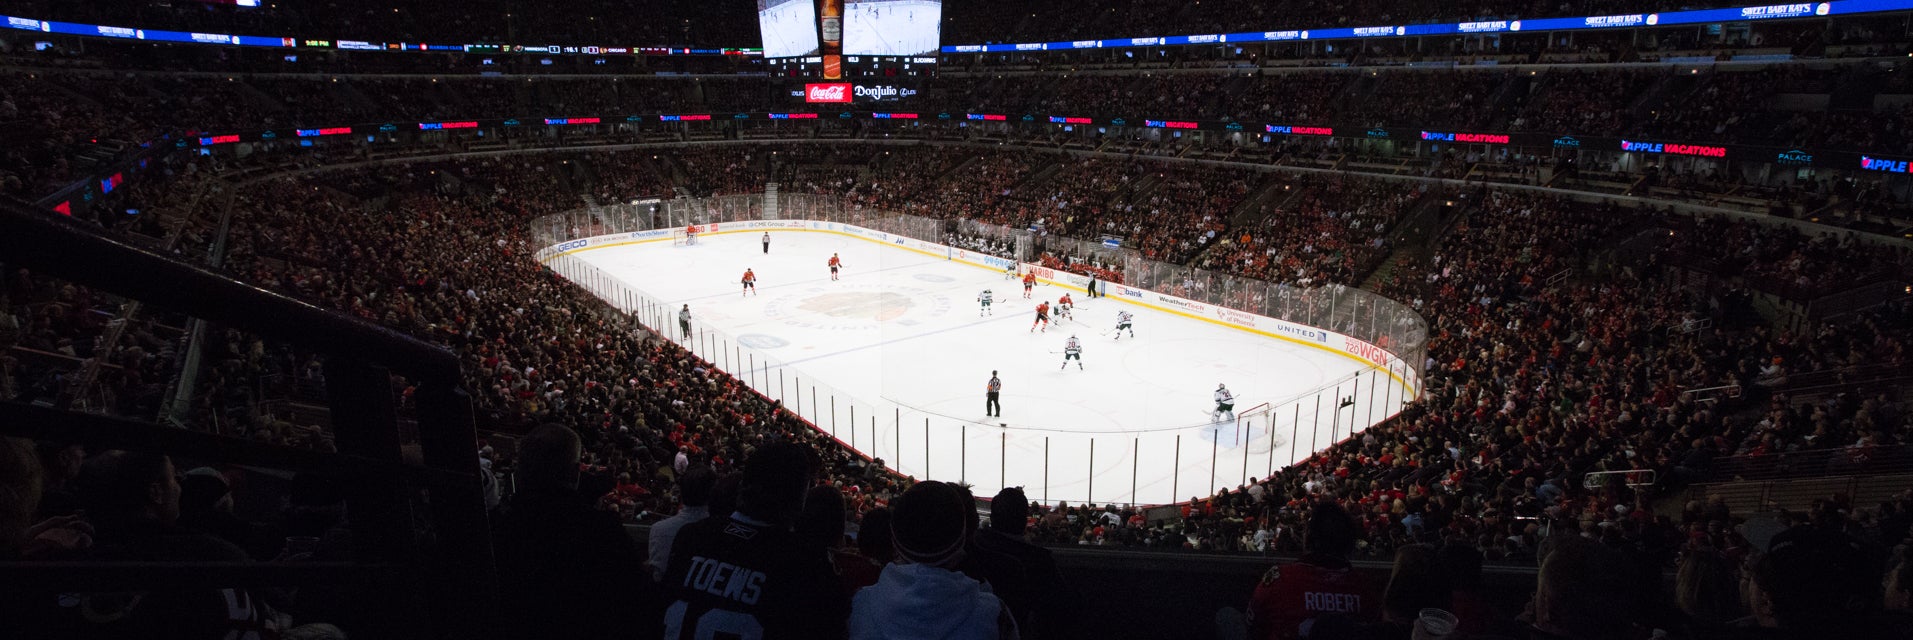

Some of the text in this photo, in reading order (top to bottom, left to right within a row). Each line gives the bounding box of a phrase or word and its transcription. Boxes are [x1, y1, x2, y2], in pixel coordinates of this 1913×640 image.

[1741, 7, 1767, 17] SWEET
[1767, 5, 1789, 14] BABY
[1585, 16, 1607, 25] SWEET
[1607, 15, 1624, 23] BABY
[1269, 125, 1333, 136] APPLE VACATIONS
[1426, 131, 1510, 144] APPLE VACATIONS
[1626, 142, 1726, 157] APPLE VACATIONS
[1778, 153, 1813, 162] PALACE
[1867, 158, 1907, 173] APPLE
[558, 239, 587, 252] GEICO
[1029, 265, 1054, 280] HARIBO
[1125, 287, 1143, 298] bank
[1159, 295, 1205, 311] WeatherTech
[1226, 310, 1255, 322] University
[1233, 317, 1256, 328] Phoenix
[1277, 324, 1315, 338] UNITED
[1345, 341, 1388, 367] 720 WGN
[683, 556, 767, 605] TOEWS
[1304, 591, 1361, 612] ROBERT
